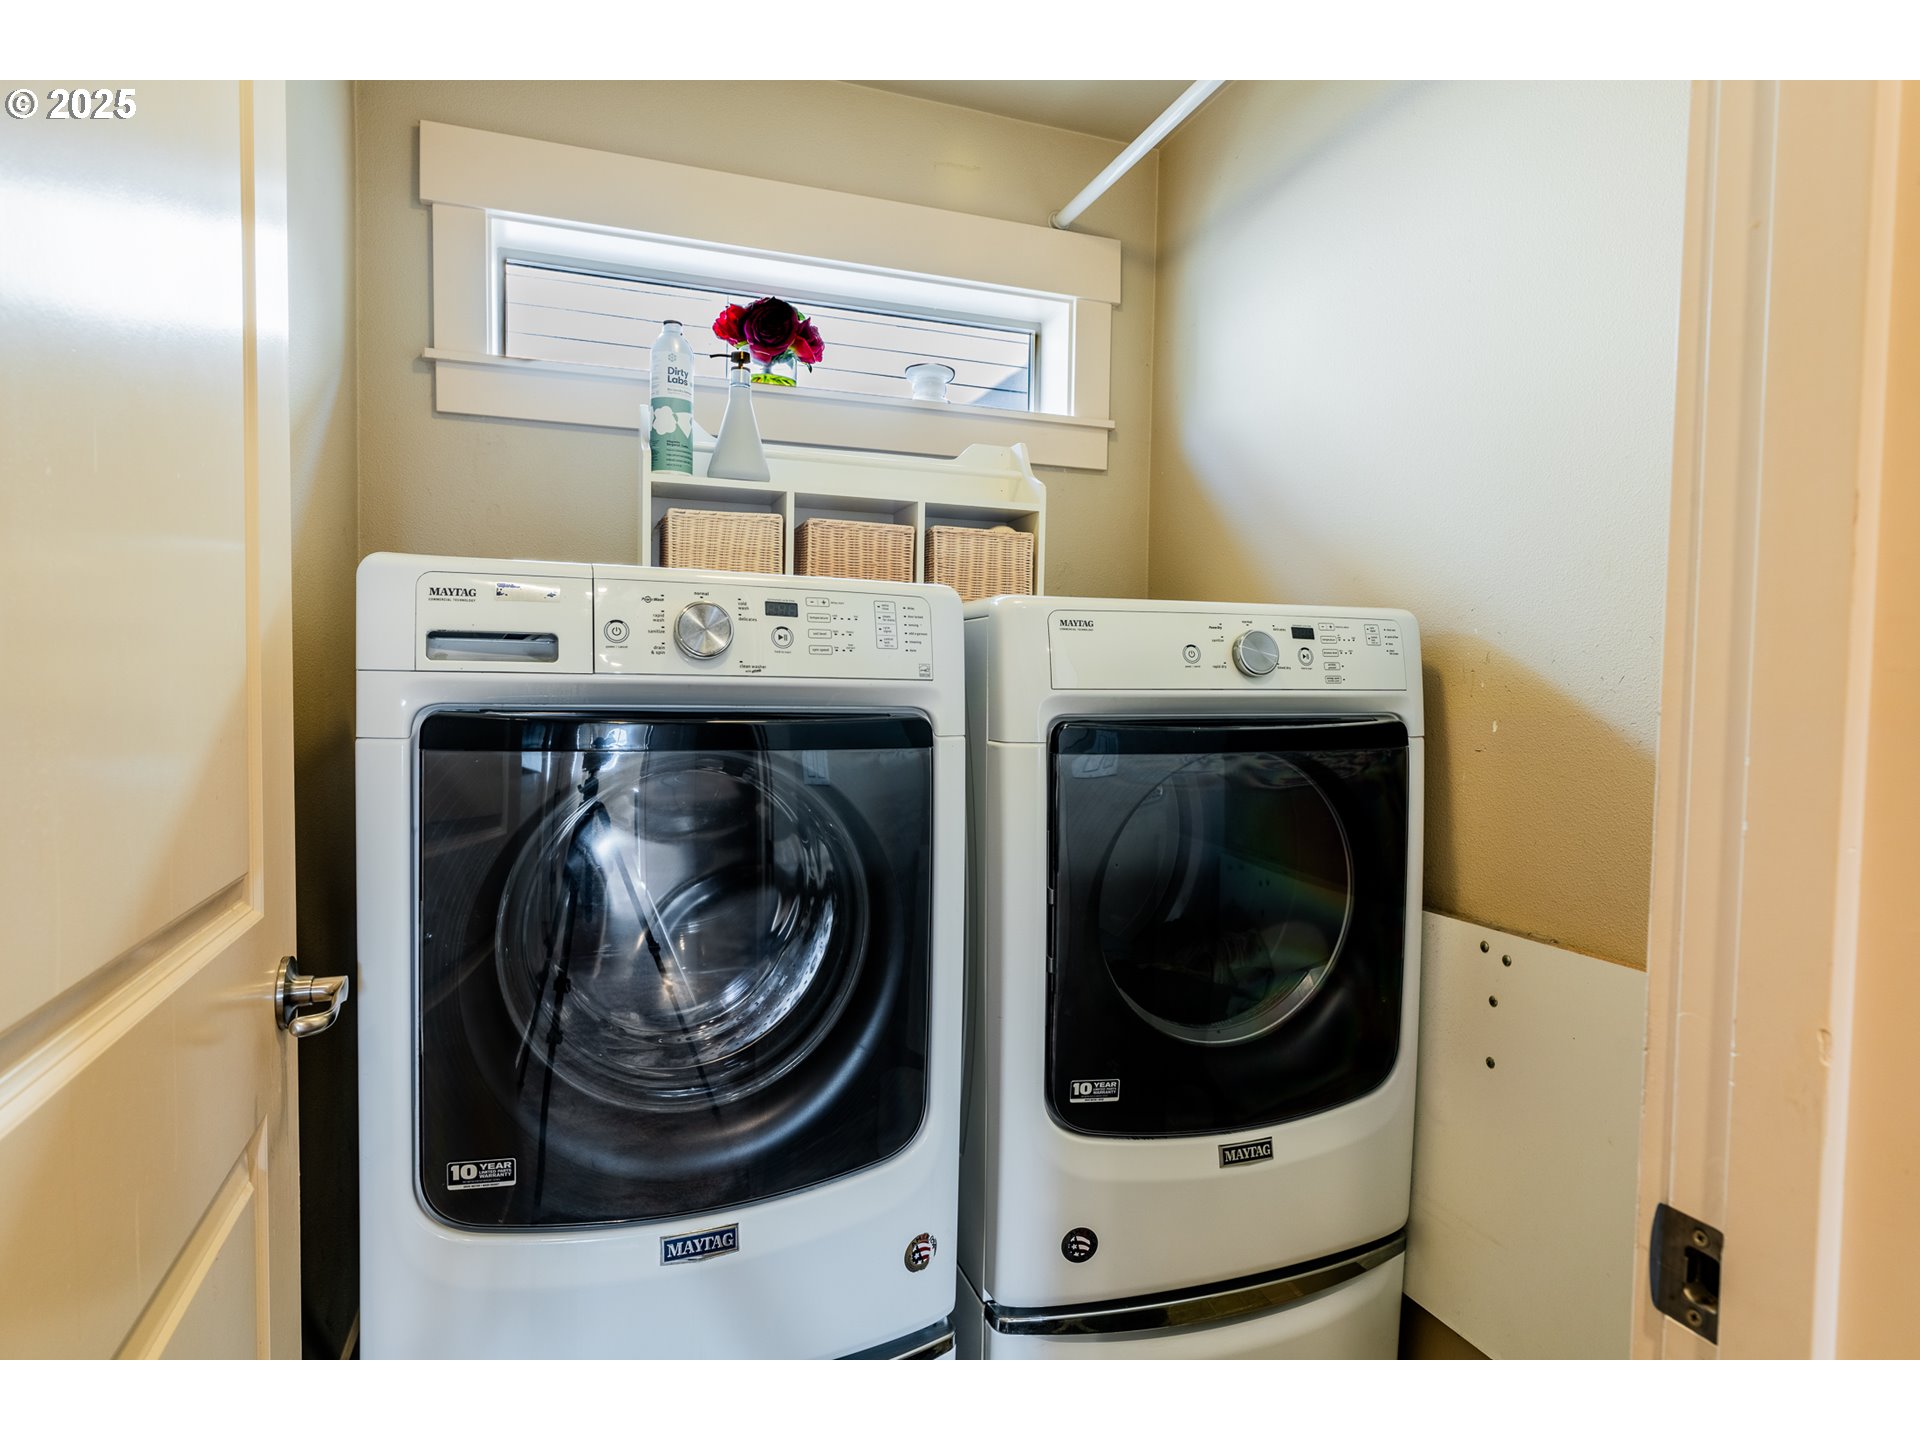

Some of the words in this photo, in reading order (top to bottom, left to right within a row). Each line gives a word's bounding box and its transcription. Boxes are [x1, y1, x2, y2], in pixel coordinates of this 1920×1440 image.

[667, 366, 689, 379] Dirty
[667, 375, 688, 386] Labs
[429, 587, 477, 597] MAYTAG
[1059, 619, 1094, 628] MAYTAG
[1073, 1082, 1093, 1096] 10
[1224, 1143, 1271, 1163] MAYTAG
[450, 1164, 478, 1181] 10
[479, 1161, 512, 1170] YEAR
[666, 1232, 735, 1258] MAYTAG
